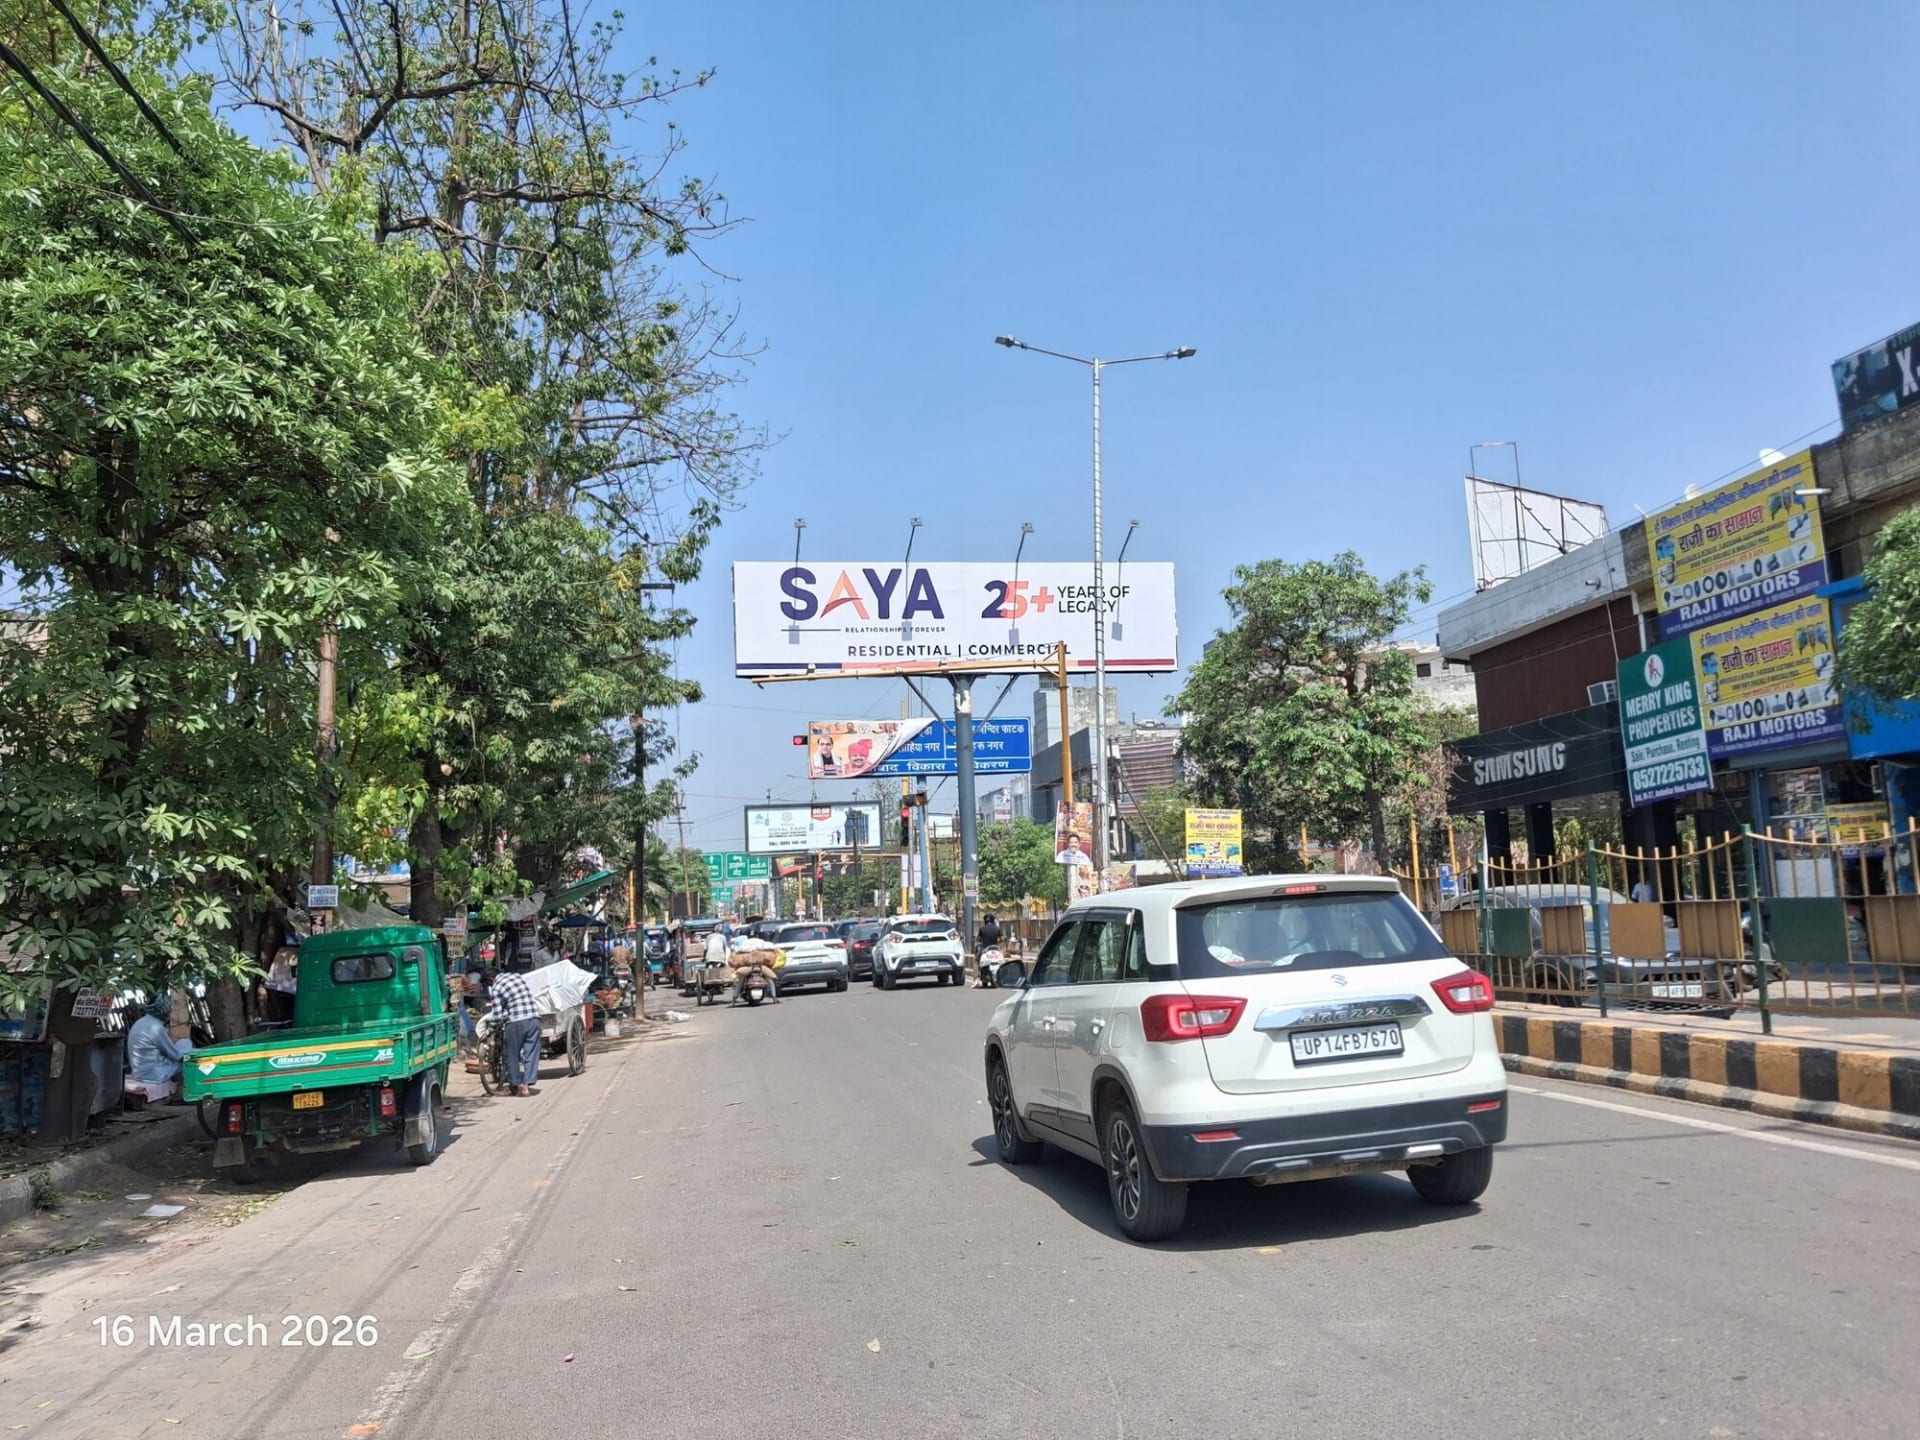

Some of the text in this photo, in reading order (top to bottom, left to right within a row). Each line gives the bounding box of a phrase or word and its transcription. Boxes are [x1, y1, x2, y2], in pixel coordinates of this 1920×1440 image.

[1678, 524, 1702, 552] राजी
[1705, 522, 1722, 543] का
[1724, 505, 1764, 535] सामान
[780, 567, 945, 621] SAYA
[981, 580, 1055, 619] 25+
[1110, 586, 1130, 599] OF
[1680, 598, 1717, 621] RAJI
[1722, 570, 1801, 608] MOTORS
[848, 645, 951, 657] RESIDENTIAL
[1744, 648, 1758, 667] का
[1759, 638, 1794, 661] सामान
[1625, 681, 1692, 719] MERRY KING
[1001, 724, 1025, 734] फाटक
[1628, 706, 1695, 742] PROPERTIES
[1723, 723, 1757, 744] RAJI
[1760, 709, 1827, 735] MOTORS
[924, 742, 941, 753] नगर
[987, 740, 1005, 751] नगर
[1676, 735, 1700, 751] Renting
[907, 760, 945, 772] विकास
[1473, 742, 1567, 785] SAMSUNG
[1633, 755, 1706, 790] 8527225733
[1304, 1029, 1400, 1056] UP14FB7670
